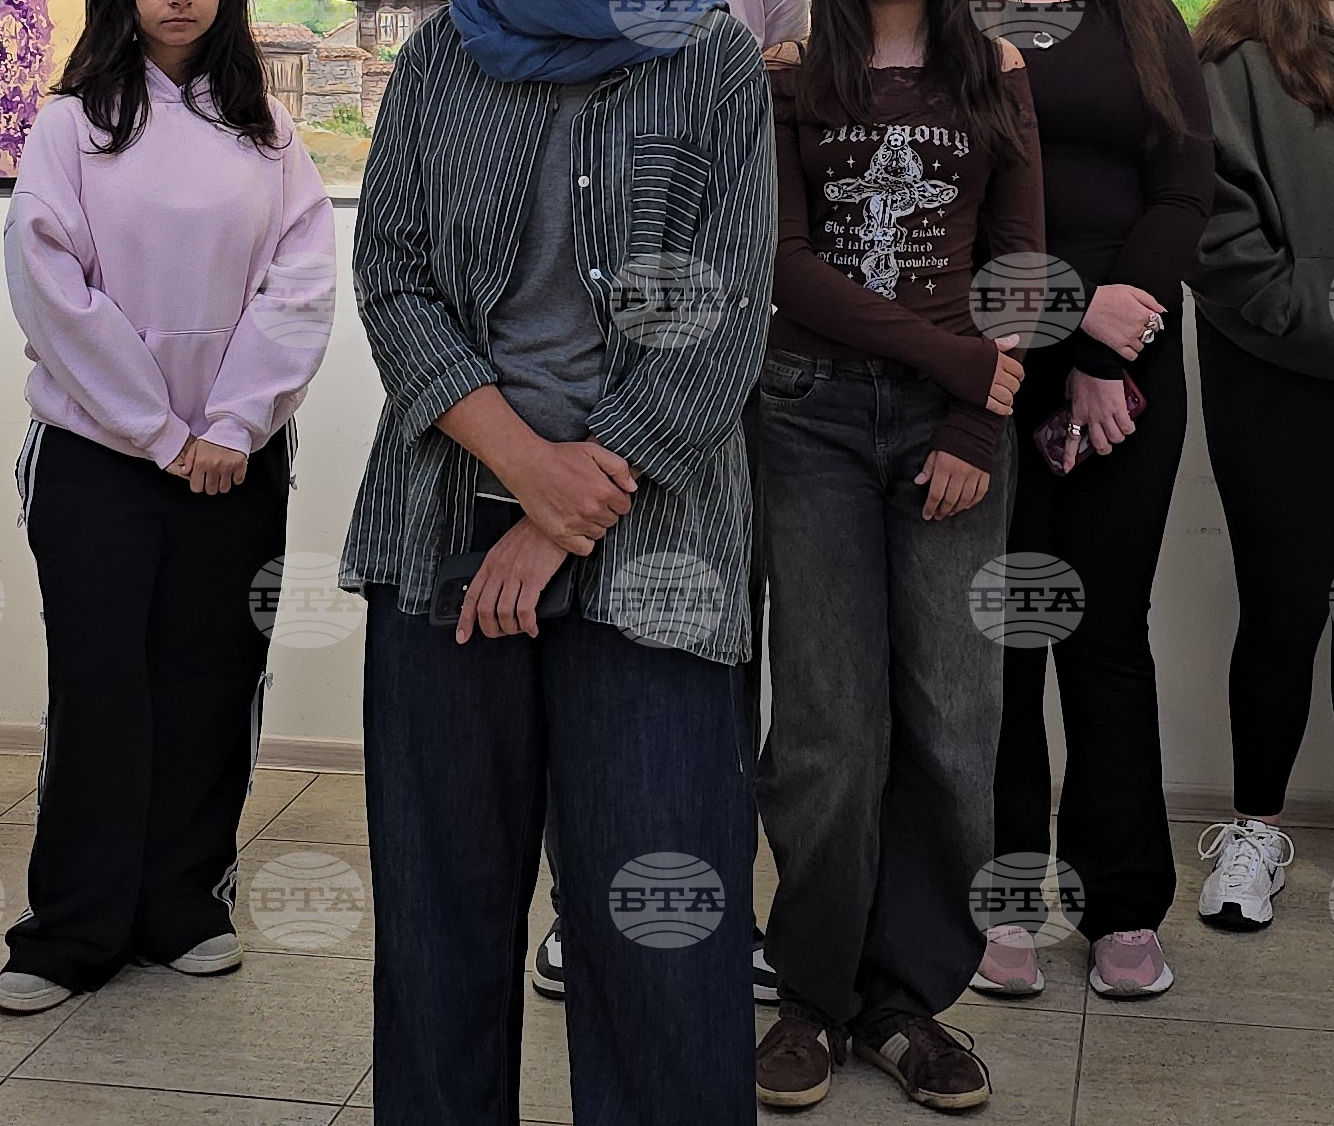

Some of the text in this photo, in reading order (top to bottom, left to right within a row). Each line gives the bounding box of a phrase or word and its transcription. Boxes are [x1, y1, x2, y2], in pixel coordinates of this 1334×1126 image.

[825, 221, 845, 234] The
[912, 225, 946, 238] snake
[848, 239, 871, 250] tale
[833, 253, 860, 267] faith
[897, 256, 949, 268] nowledge
